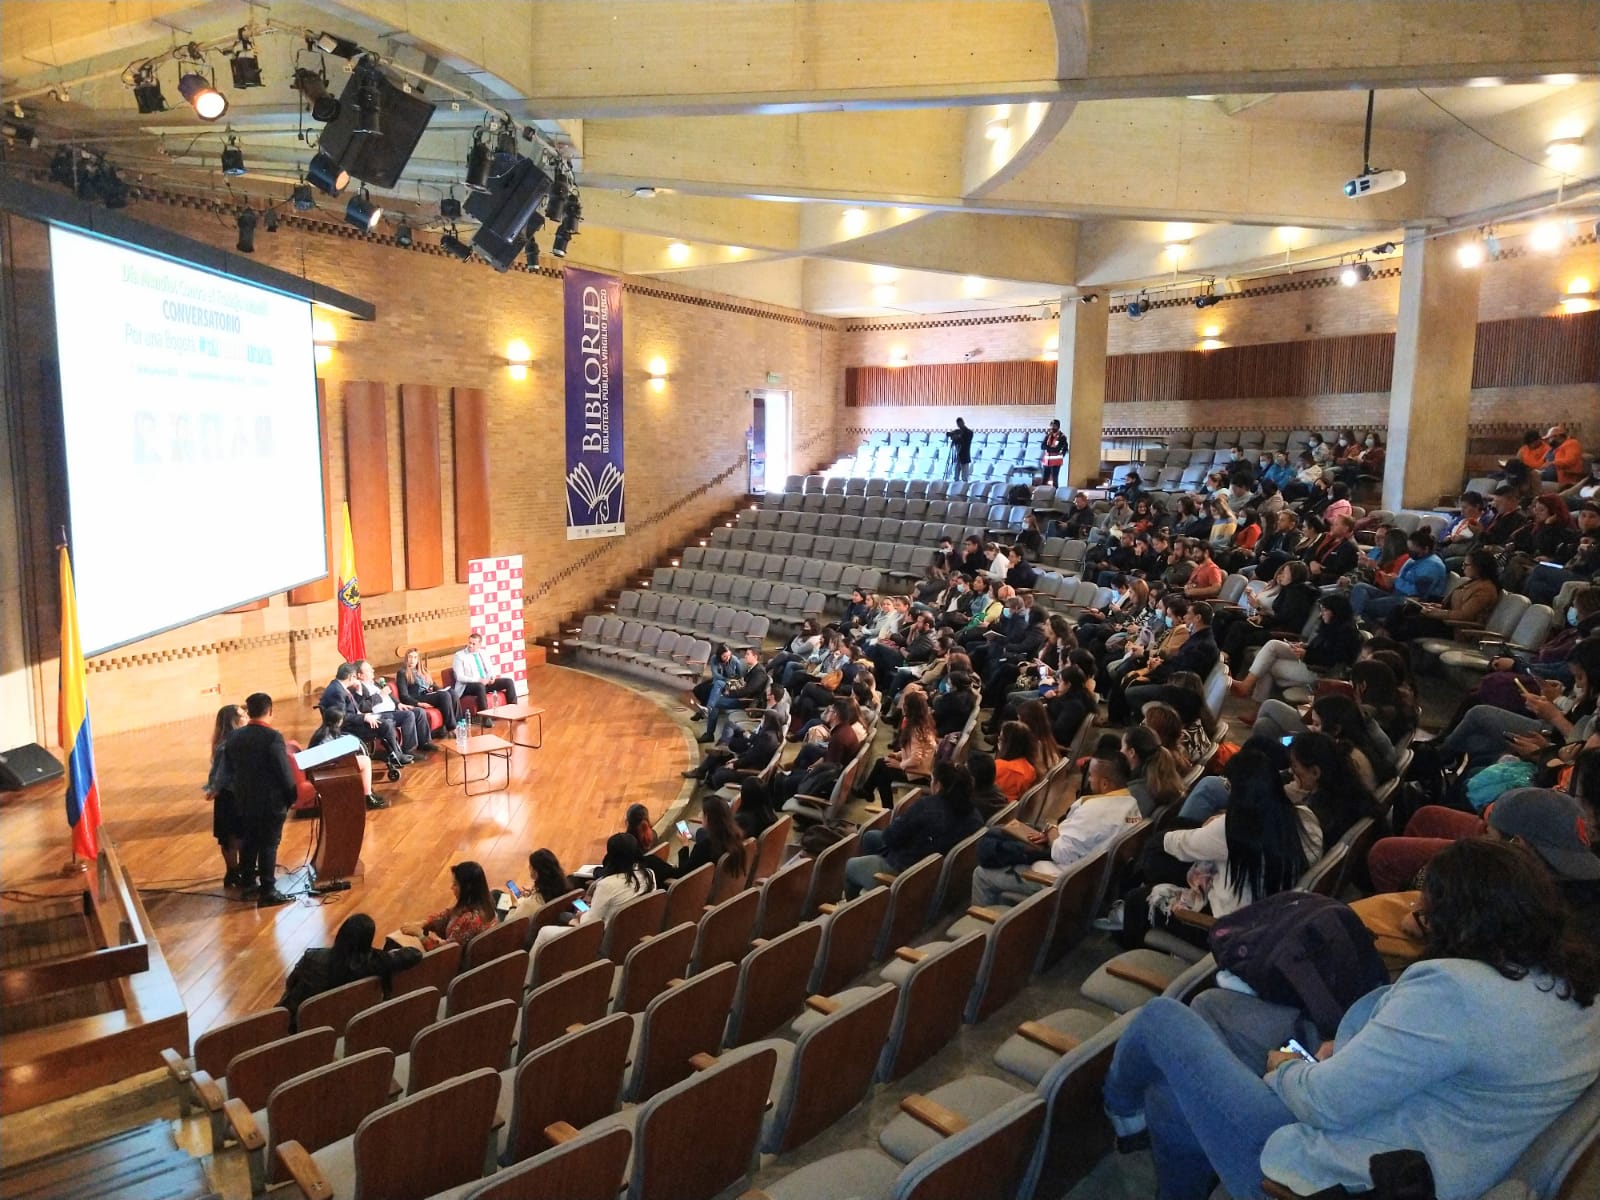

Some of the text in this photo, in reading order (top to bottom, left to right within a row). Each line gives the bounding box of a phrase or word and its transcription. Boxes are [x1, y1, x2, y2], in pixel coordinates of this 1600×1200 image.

[162, 299, 241, 335] CONVERSATORIO
[600, 288, 608, 320] BARCO
[601, 363, 609, 401] PÚBLICA
[602, 402, 610, 454] BIBLIOTECA
